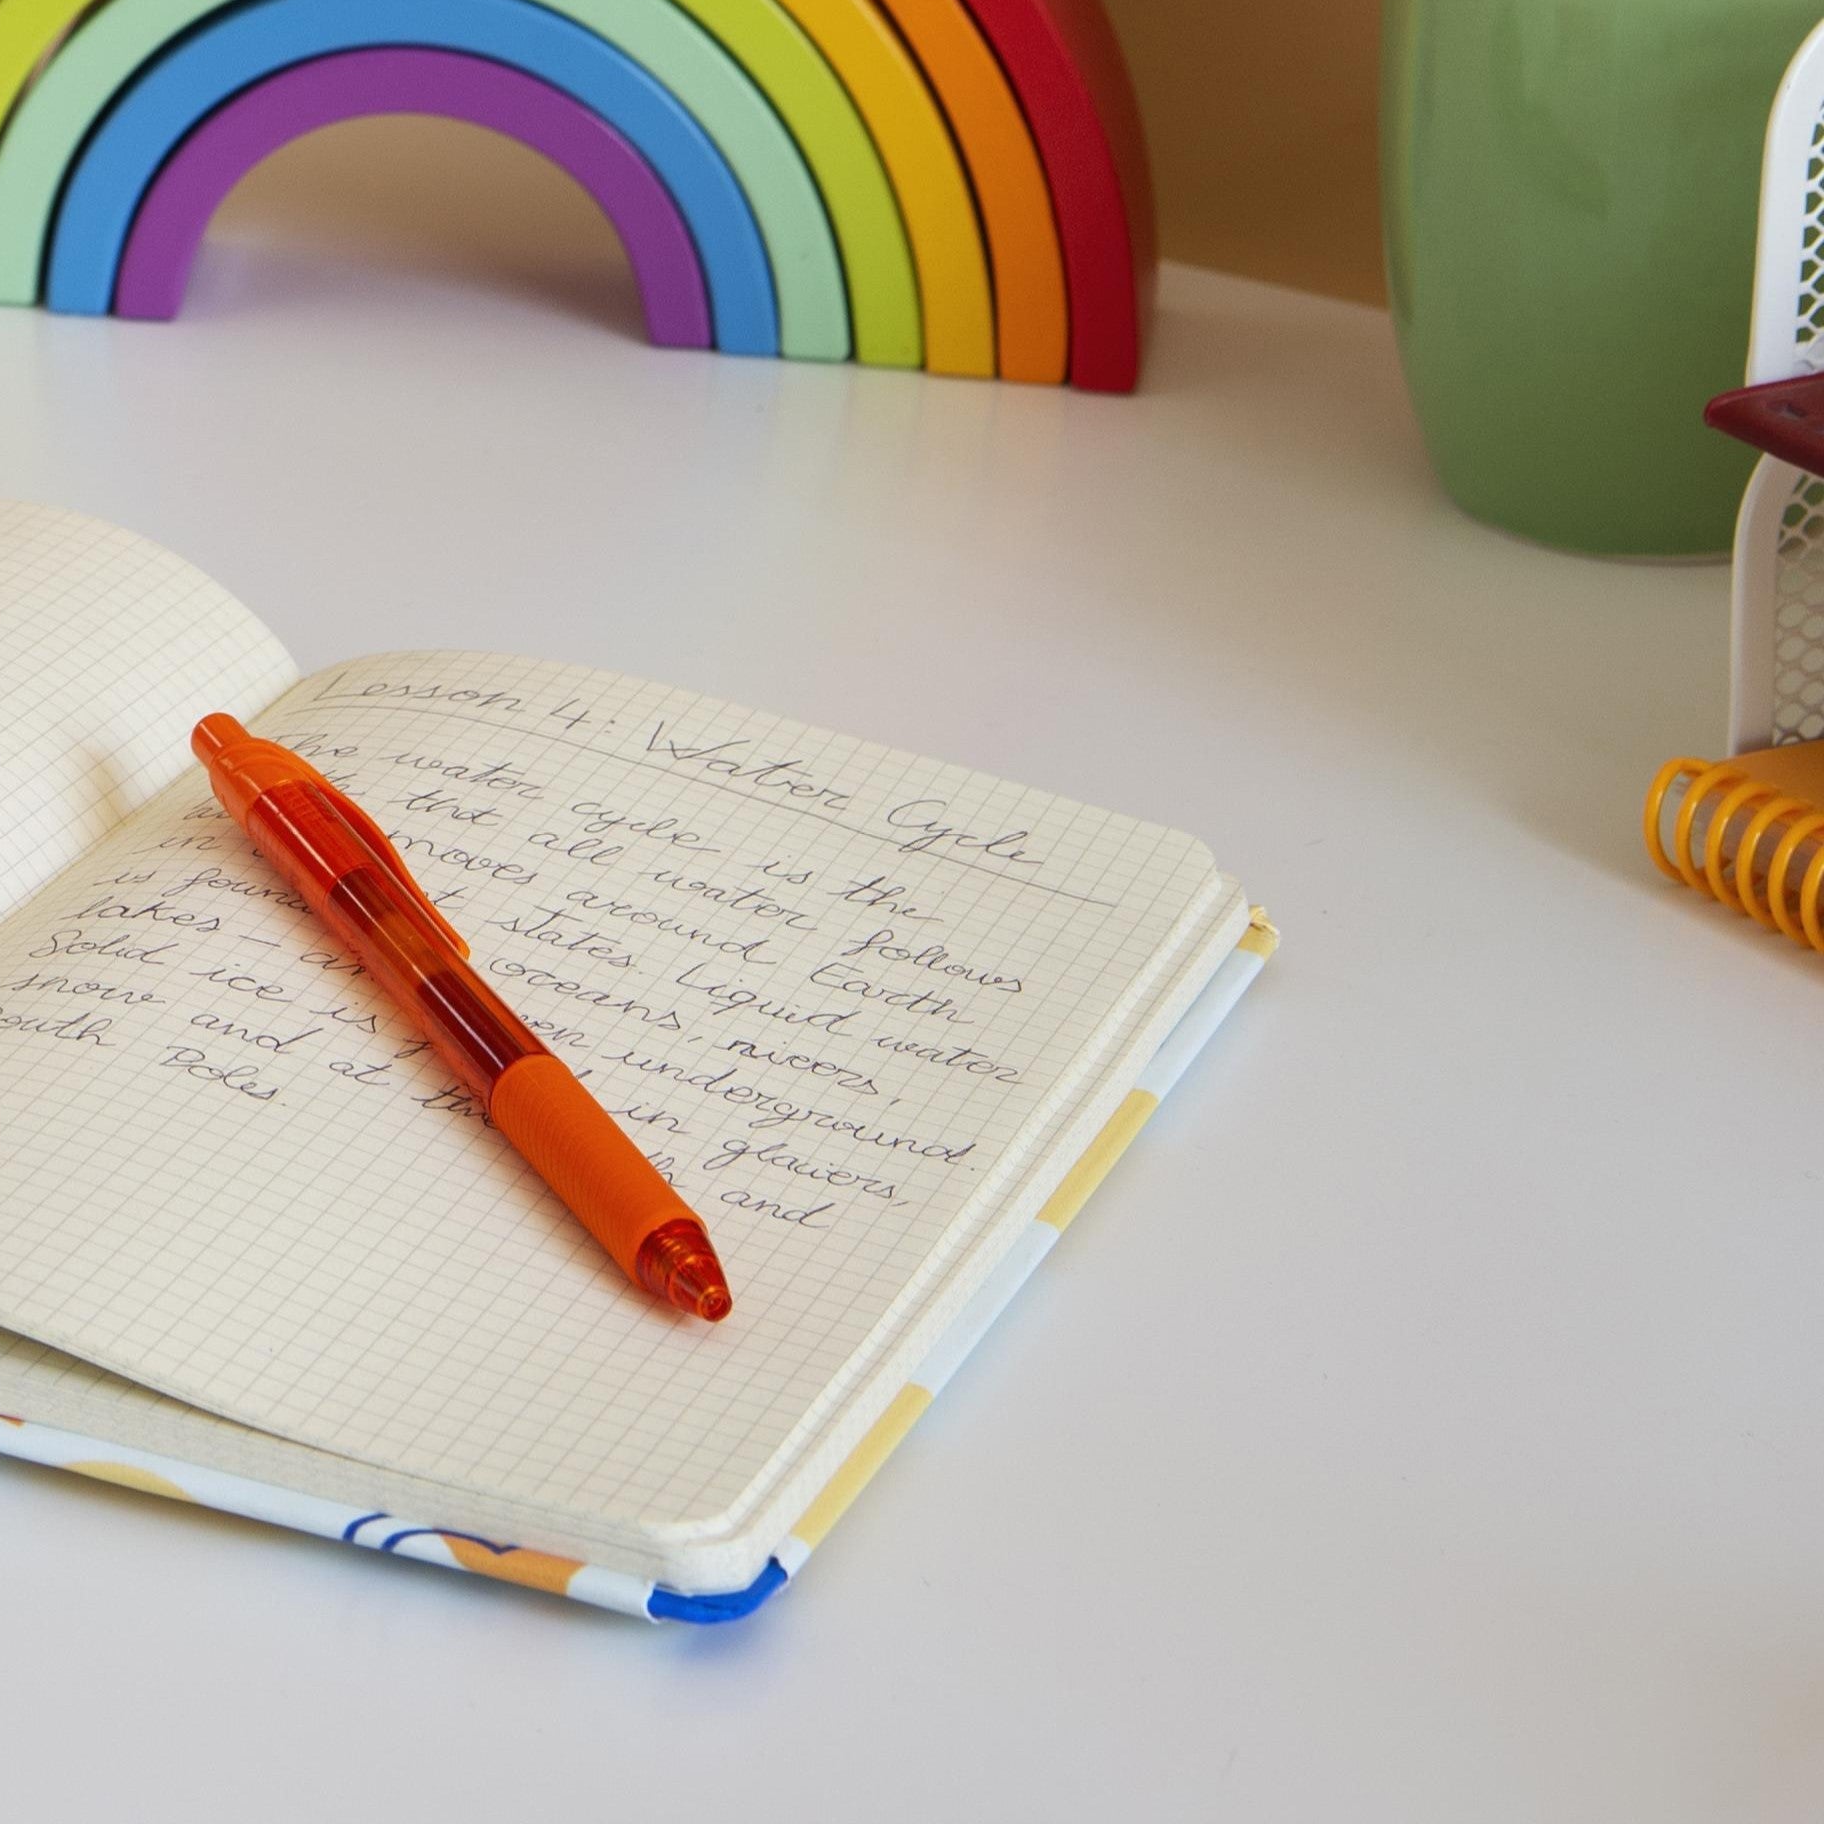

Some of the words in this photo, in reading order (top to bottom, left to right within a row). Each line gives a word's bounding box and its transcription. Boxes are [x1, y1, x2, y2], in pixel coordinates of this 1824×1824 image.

[312, 671, 525, 713] Lesson
[549, 697, 616, 735] 4:
[645, 720, 850, 811] Water
[887, 799, 1044, 864] Cycle
[93, 866, 157, 886] is
[132, 836, 223, 855] in
[379, 752, 544, 800] water
[571, 801, 721, 853] cycle
[748, 854, 814, 885] is
[827, 876, 944, 922] the
[387, 789, 503, 827] that
[527, 832, 624, 866] all
[638, 870, 818, 930] water
[840, 929, 1022, 993] follows
[59, 895, 221, 933] lakes
[387, 829, 538, 884] moves
[566, 890, 777, 964] around
[810, 961, 975, 1024] Earth
[28, 929, 180, 965] Solid
[188, 963, 294, 1003] ice
[308, 1001, 378, 1034] is
[484, 904, 644, 975] states.
[675, 962, 863, 1036] Liquid
[872, 1035, 1023, 1084] water
[488, 957, 703, 1043] oceans,
[711, 1040, 901, 1106] rivers,
[190, 1013, 324, 1054] and
[328, 1061, 393, 1085] at
[601, 1050, 976, 1172] underground.
[608, 1102, 691, 1134] in
[702, 1138, 910, 1207] glaciers,
[720, 1190, 836, 1228] and
